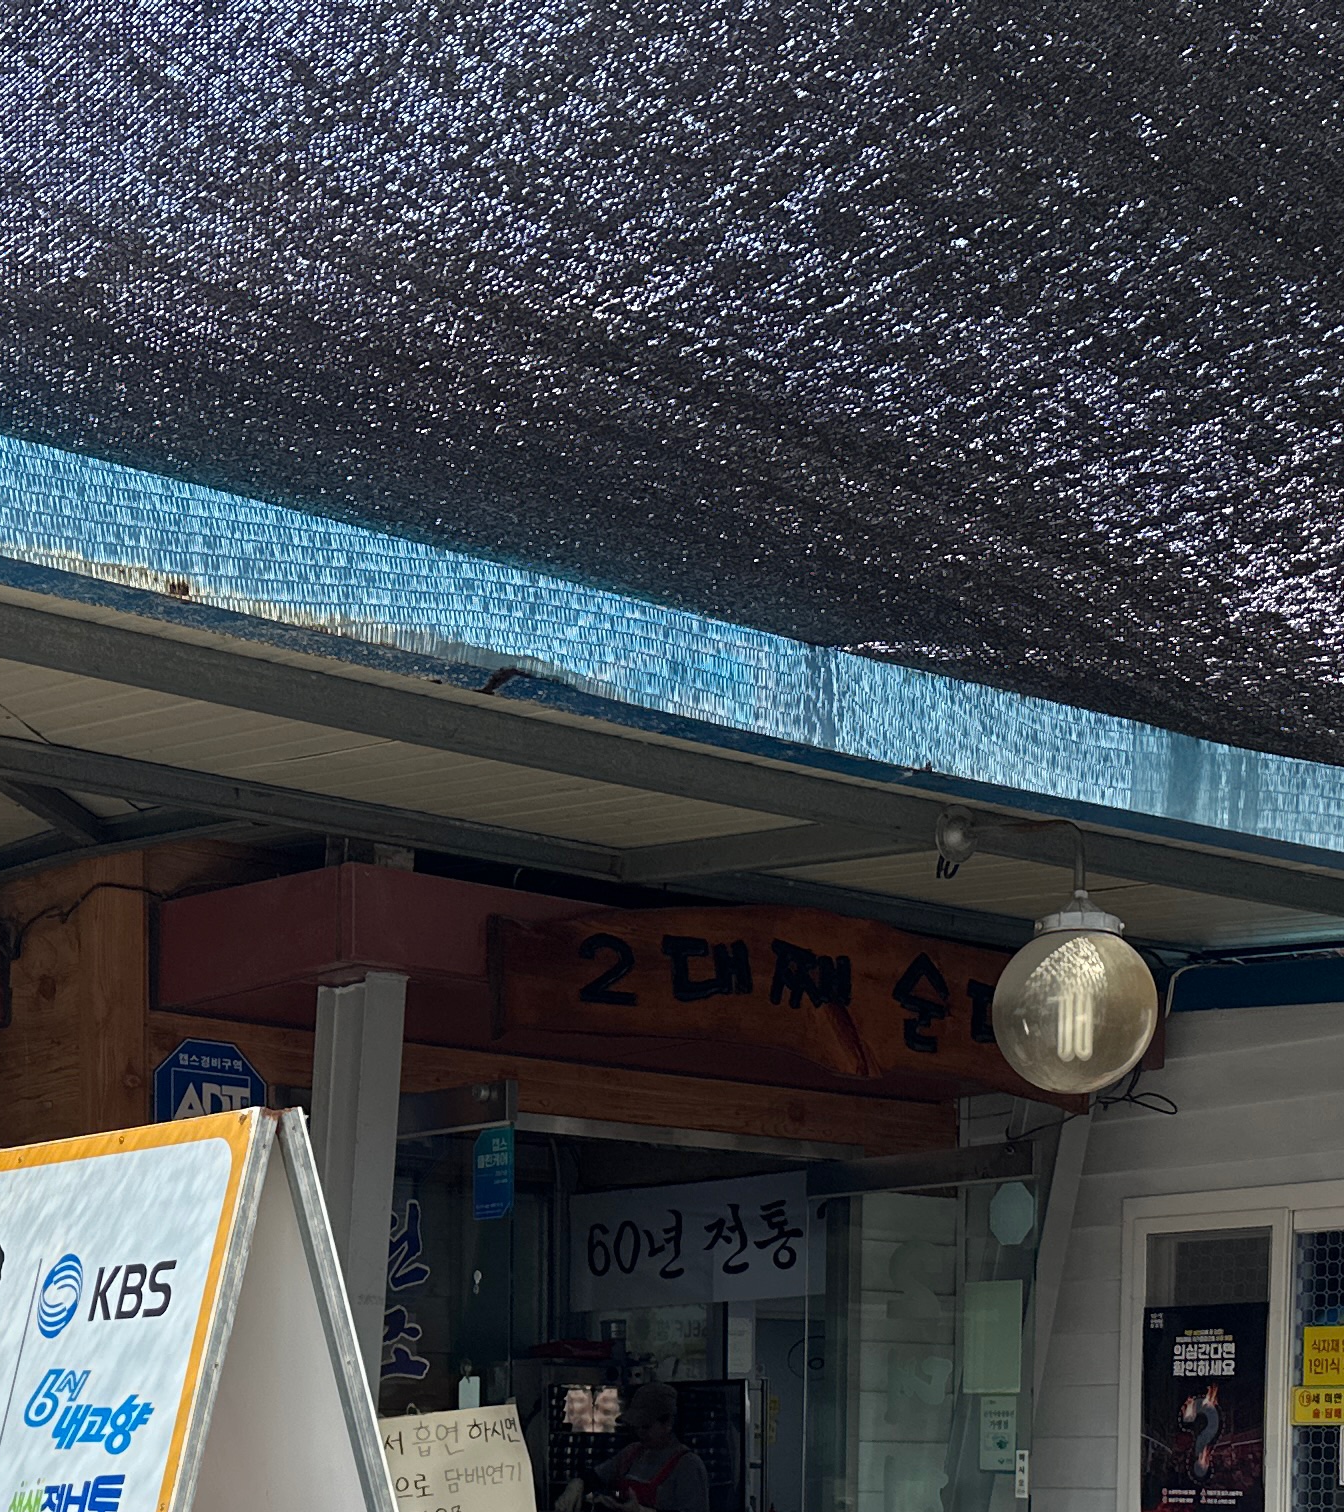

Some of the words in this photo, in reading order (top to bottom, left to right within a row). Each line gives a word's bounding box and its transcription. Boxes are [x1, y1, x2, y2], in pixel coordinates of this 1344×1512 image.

[178, 1052, 243, 1073] 캡스경비구역
[173, 1081, 251, 1121] ADT
[586, 1208, 685, 1280] 60년
[703, 1199, 805, 1275] 전통
[86, 1258, 177, 1321] KBS
[1311, 1338, 1340, 1354] 식자재
[1172, 1360, 1236, 1377] 확인하세요
[1308, 1357, 1341, 1375] 1인1식
[1324, 1393, 1343, 1404] 미만
[52, 1392, 156, 1456] 내고향
[412, 1420, 465, 1457] 흡연
[466, 1416, 521, 1443] 하시면
[444, 1462, 522, 1494] 담배연기
